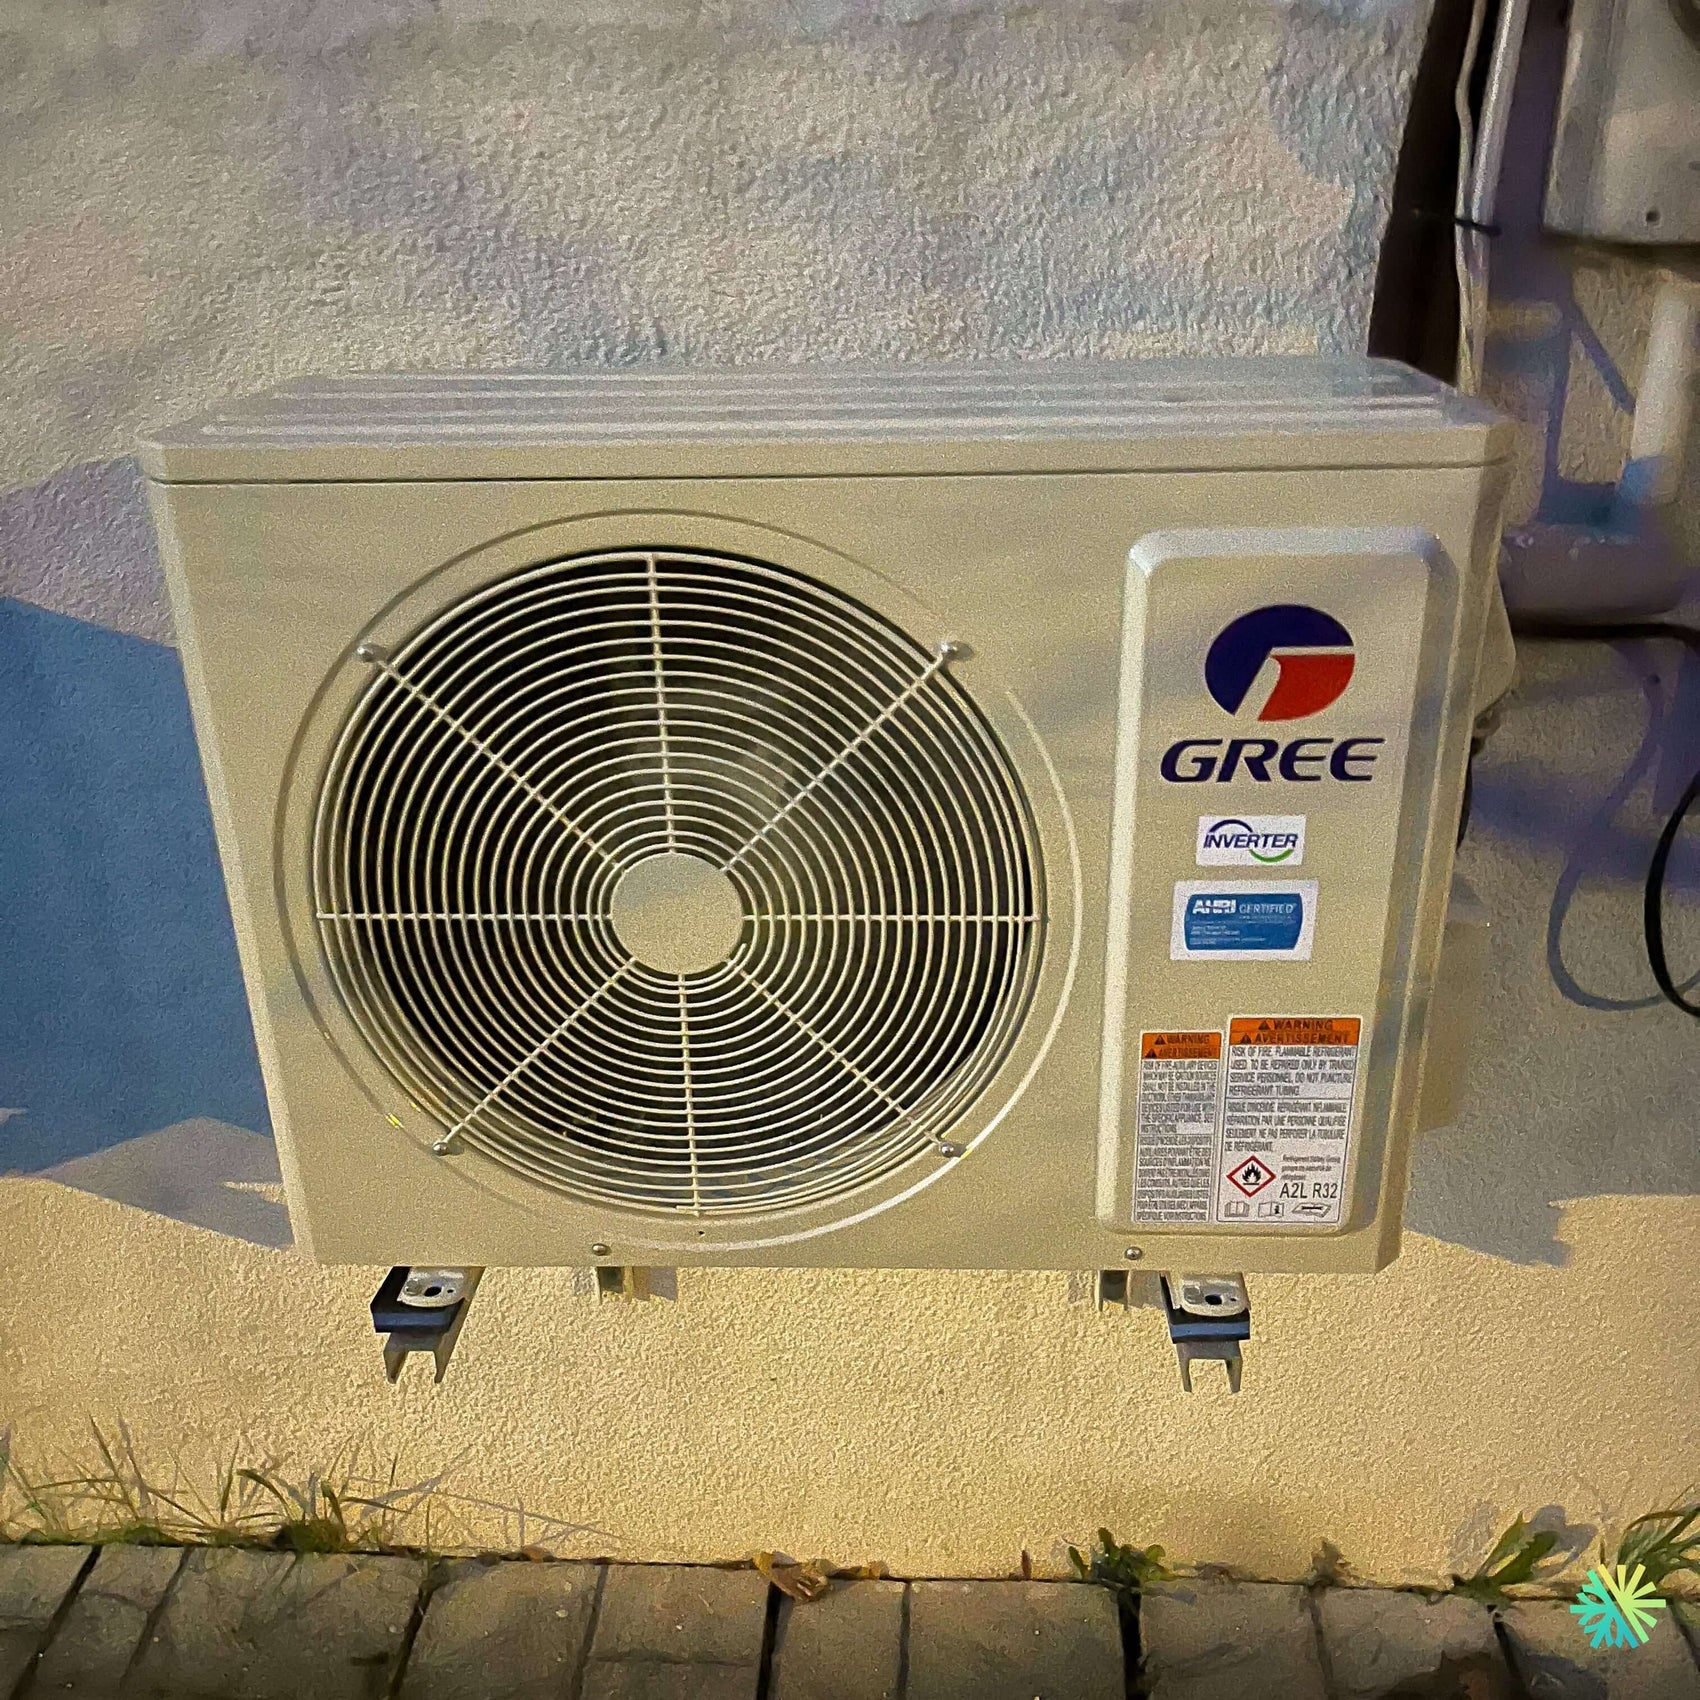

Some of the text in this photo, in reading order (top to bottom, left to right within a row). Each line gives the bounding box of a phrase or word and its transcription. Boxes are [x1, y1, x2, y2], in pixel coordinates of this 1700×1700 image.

[1160, 738, 1385, 783] GREE
[1203, 833, 1299, 849] INVERTER
[1239, 903, 1294, 914] CERTIFIED
[1273, 1020, 1333, 1031] WARNING
[1166, 1034, 1210, 1044] WARNING
[1254, 1032, 1350, 1044] AVERTISSEMENT
[1279, 1182, 1338, 1199] A2L R32
